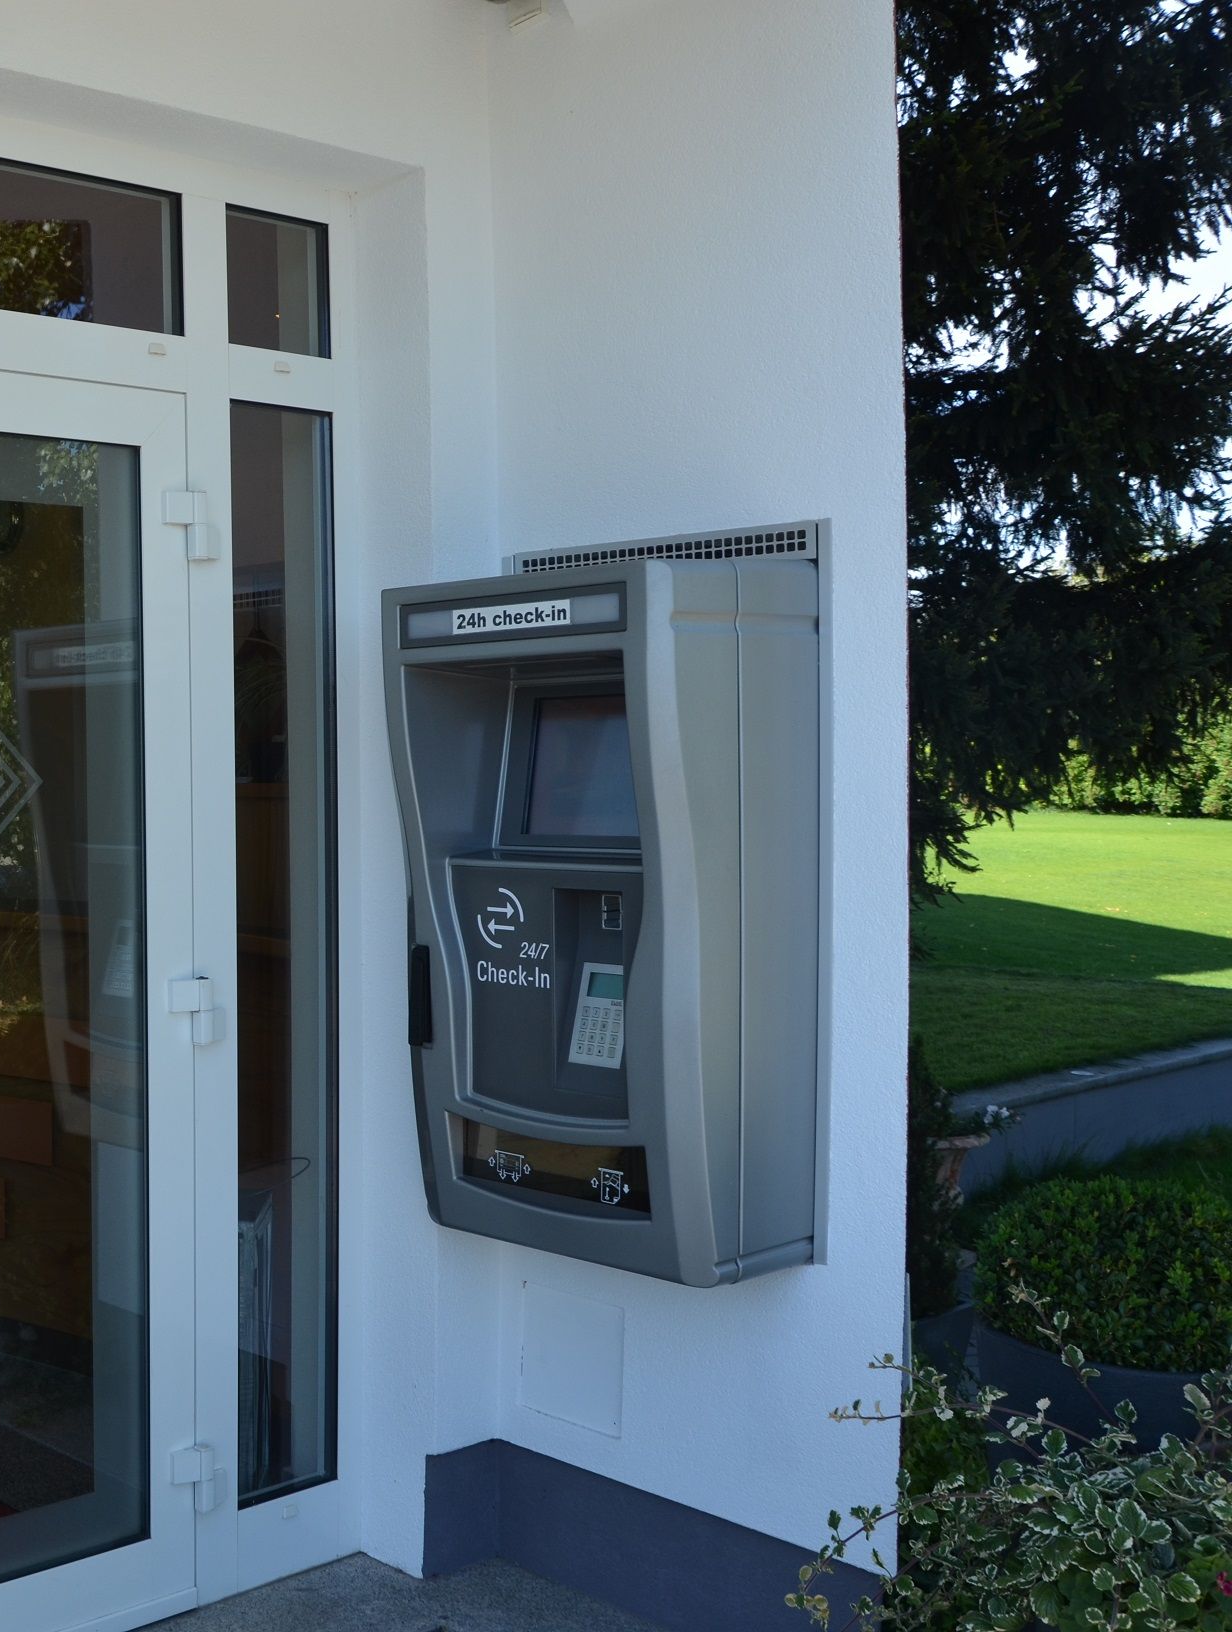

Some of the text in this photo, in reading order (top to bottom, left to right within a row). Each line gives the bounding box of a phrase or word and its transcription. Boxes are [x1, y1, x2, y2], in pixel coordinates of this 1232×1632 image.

[456, 605, 568, 630] 24h check-in
[519, 942, 550, 960] 24/7
[477, 960, 551, 989] Check-In
